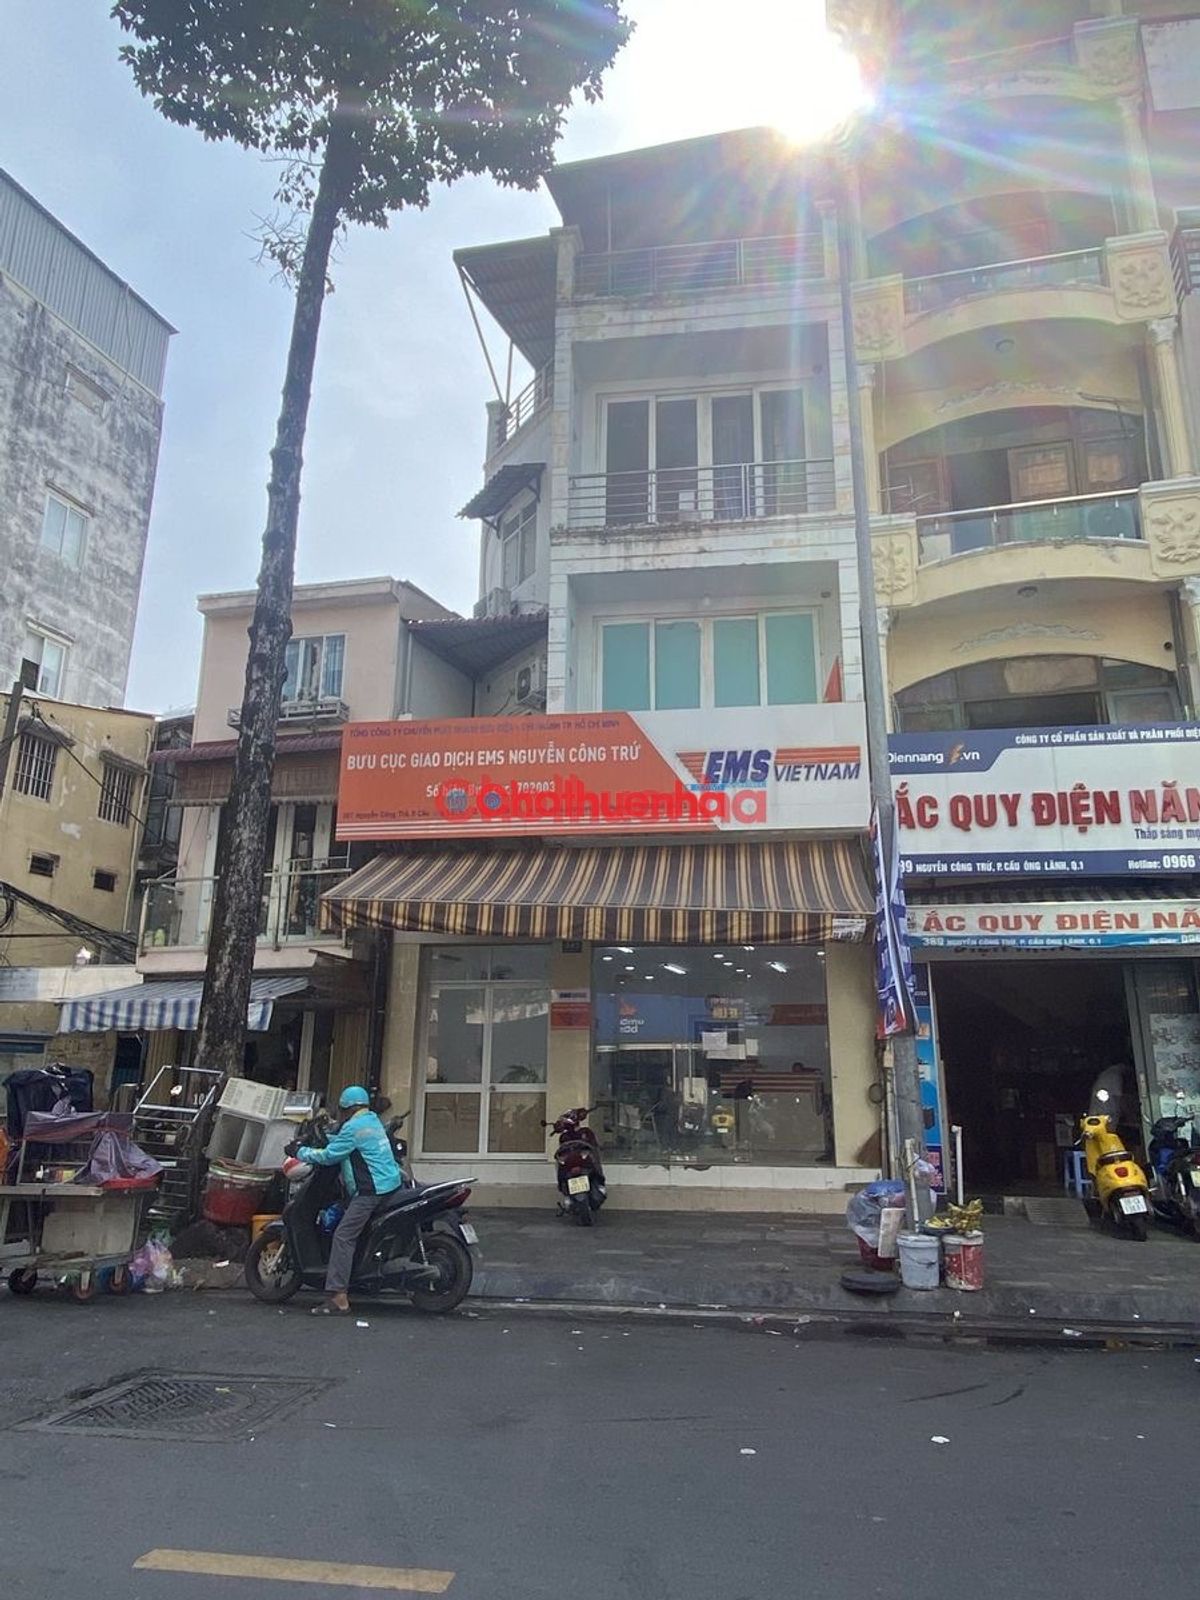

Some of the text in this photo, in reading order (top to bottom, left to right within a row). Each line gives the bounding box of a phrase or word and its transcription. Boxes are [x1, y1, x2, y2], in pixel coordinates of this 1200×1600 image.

[1039, 734, 1050, 743] TY
[347, 741, 642, 773] BƯU CỤC GIAO DỊCH EMS NGUYỄN CÔNG TRỨ
[705, 749, 772, 784] EMS
[774, 763, 860, 782] VIETNAM
[950, 793, 1022, 832] QUY
[1031, 783, 1121, 833] ĐIỆN
[1162, 854, 1196, 869] 0966
[922, 909, 966, 932] ẮC
[978, 914, 1043, 933] QUY
[1056, 909, 1139, 933] ĐIỆN
